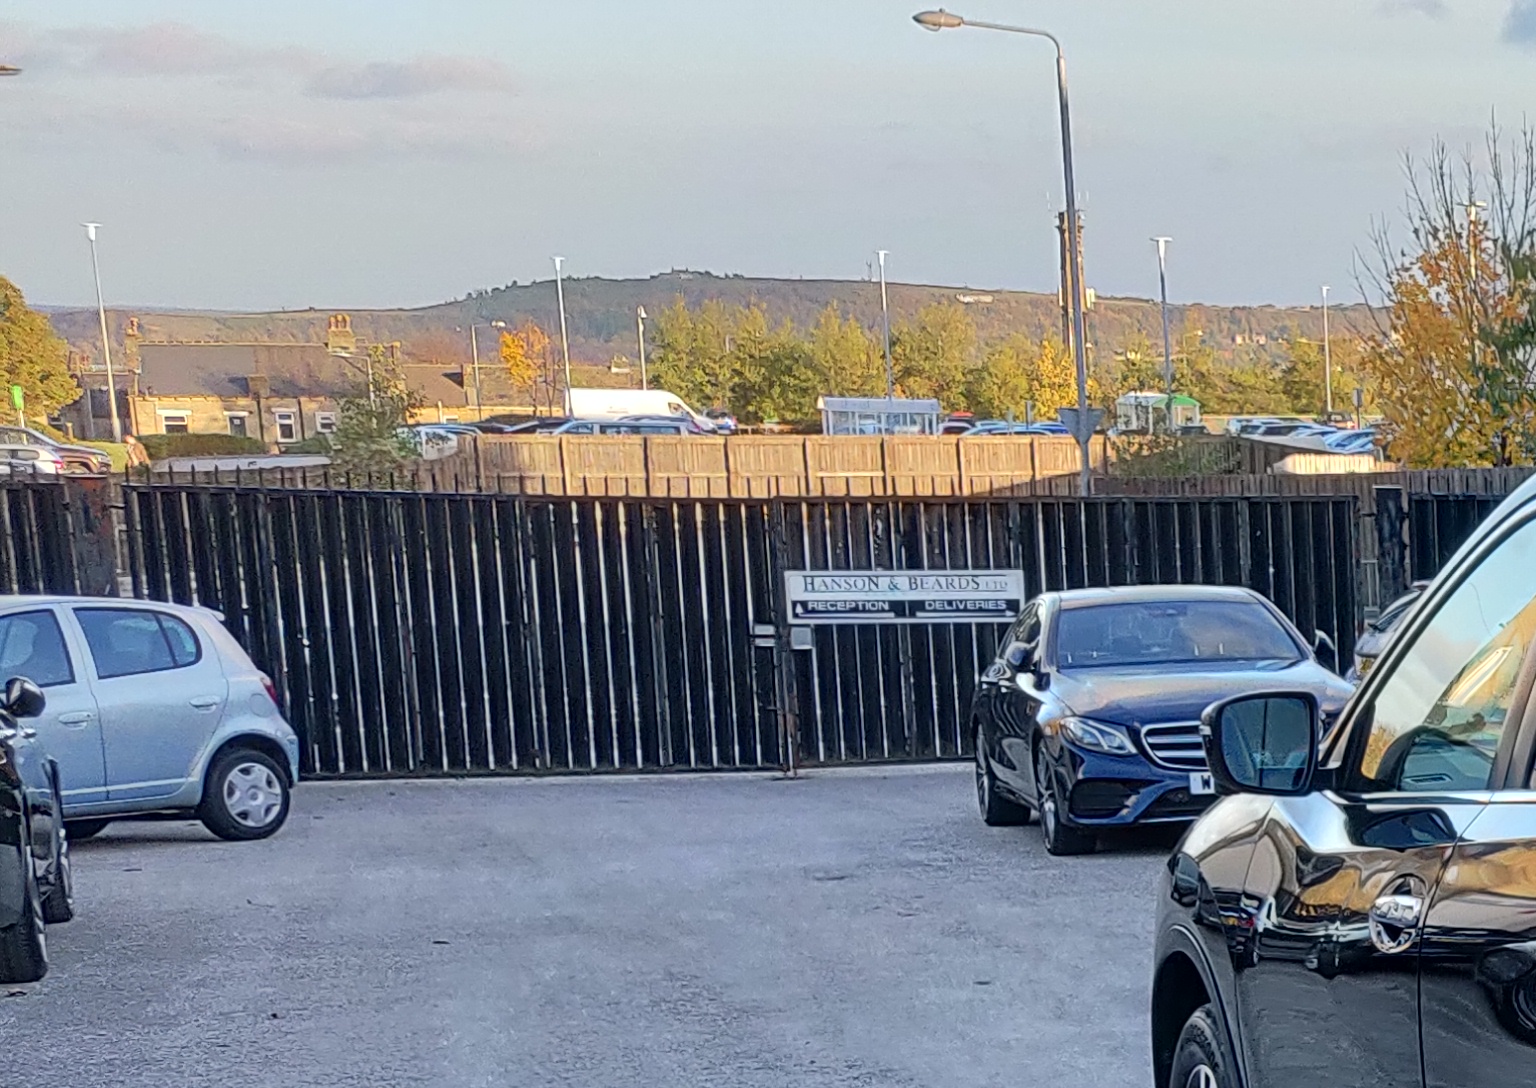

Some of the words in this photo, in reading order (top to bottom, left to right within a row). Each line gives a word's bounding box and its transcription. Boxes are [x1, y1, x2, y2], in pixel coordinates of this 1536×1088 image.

[803, 575, 880, 593] HANSON
[888, 575, 901, 591] &
[908, 575, 980, 591] BEARDS
[985, 580, 1008, 590] LTD
[807, 600, 890, 611] RECEPTION
[924, 599, 1007, 611] DELIVERIES
